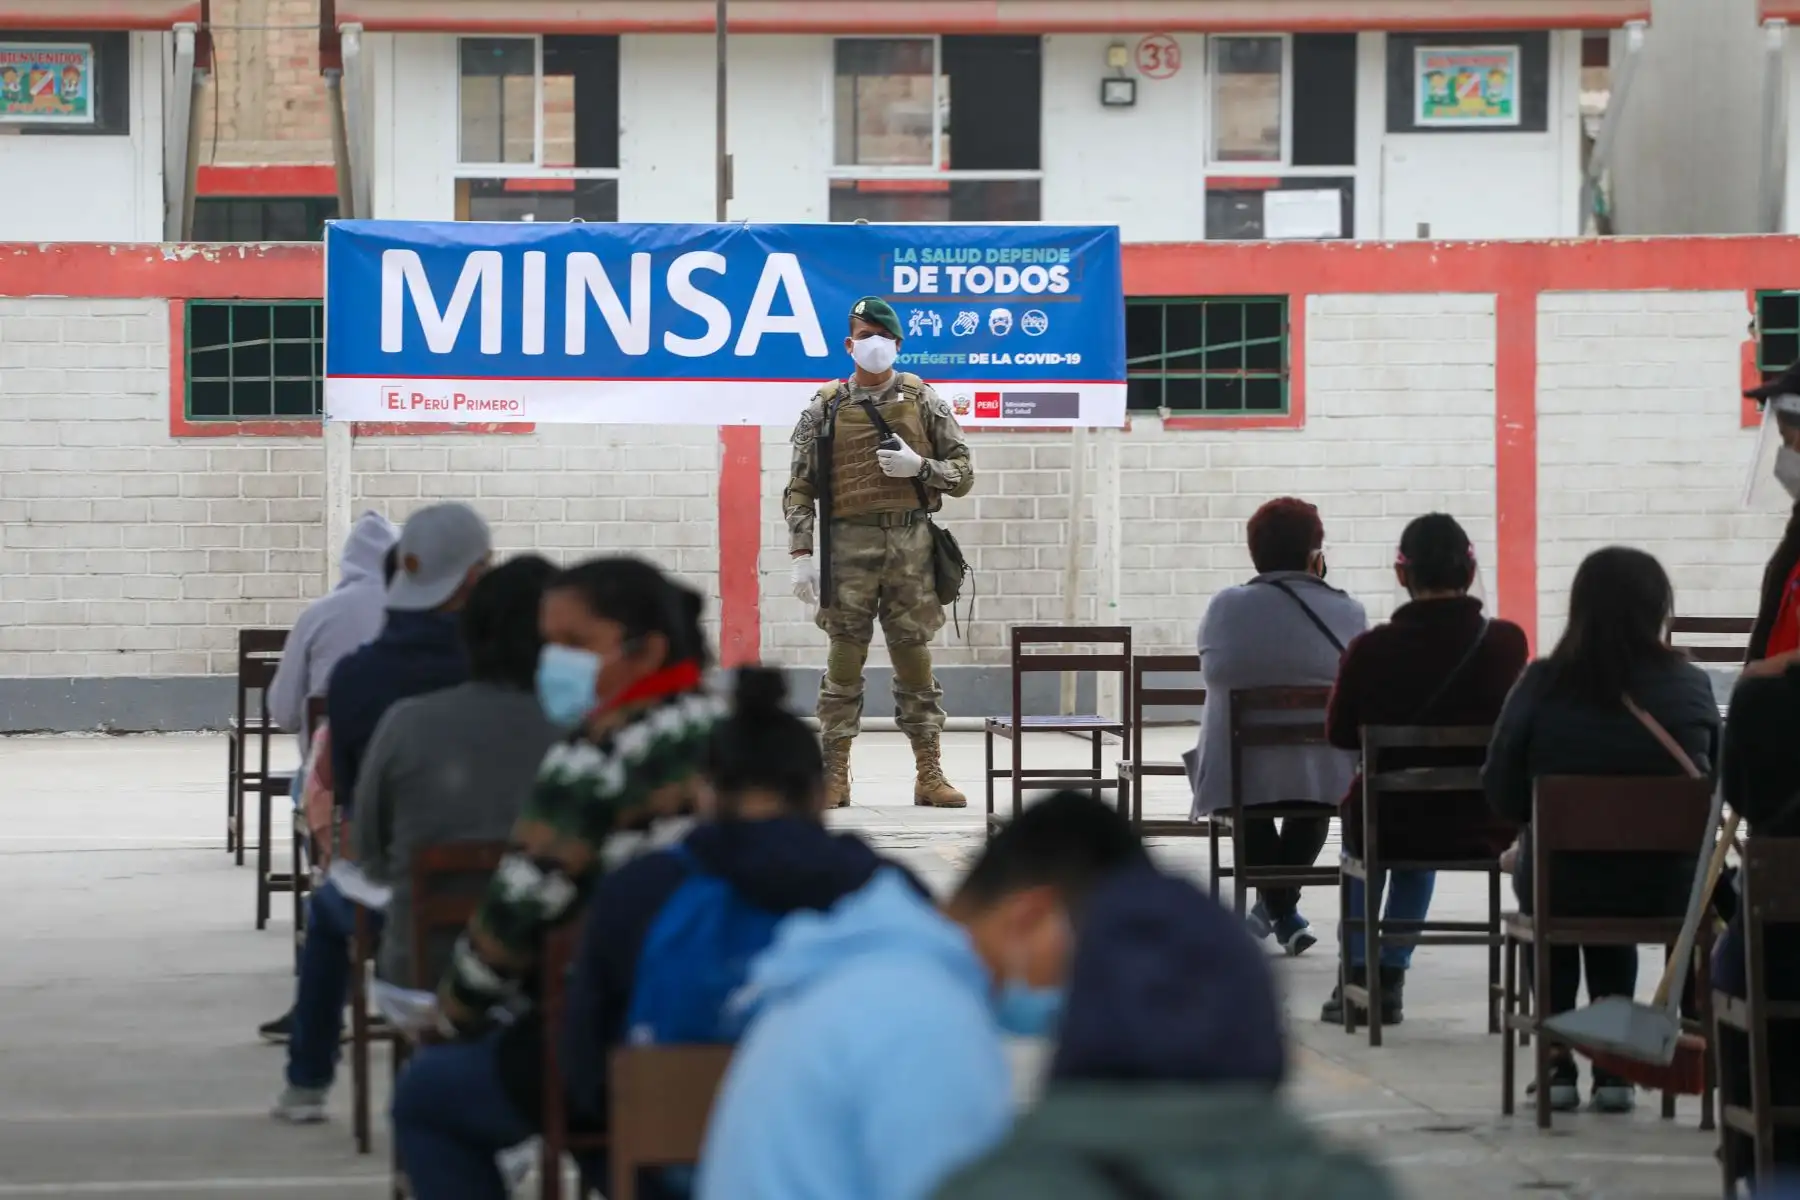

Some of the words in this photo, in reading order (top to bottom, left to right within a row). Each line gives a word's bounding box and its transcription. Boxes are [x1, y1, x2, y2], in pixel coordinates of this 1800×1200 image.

[894, 248, 917, 263] LA
[921, 248, 981, 263] SALUD
[986, 248, 1070, 263] DEPENDE
[893, 265, 938, 293] DE
[945, 265, 1070, 294] TODOS
[380, 248, 829, 357] MINSA
[894, 351, 966, 364] ROTÉGETE
[968, 353, 990, 365] DE
[992, 353, 1011, 365] LA
[1014, 353, 1081, 365] COVID-19
